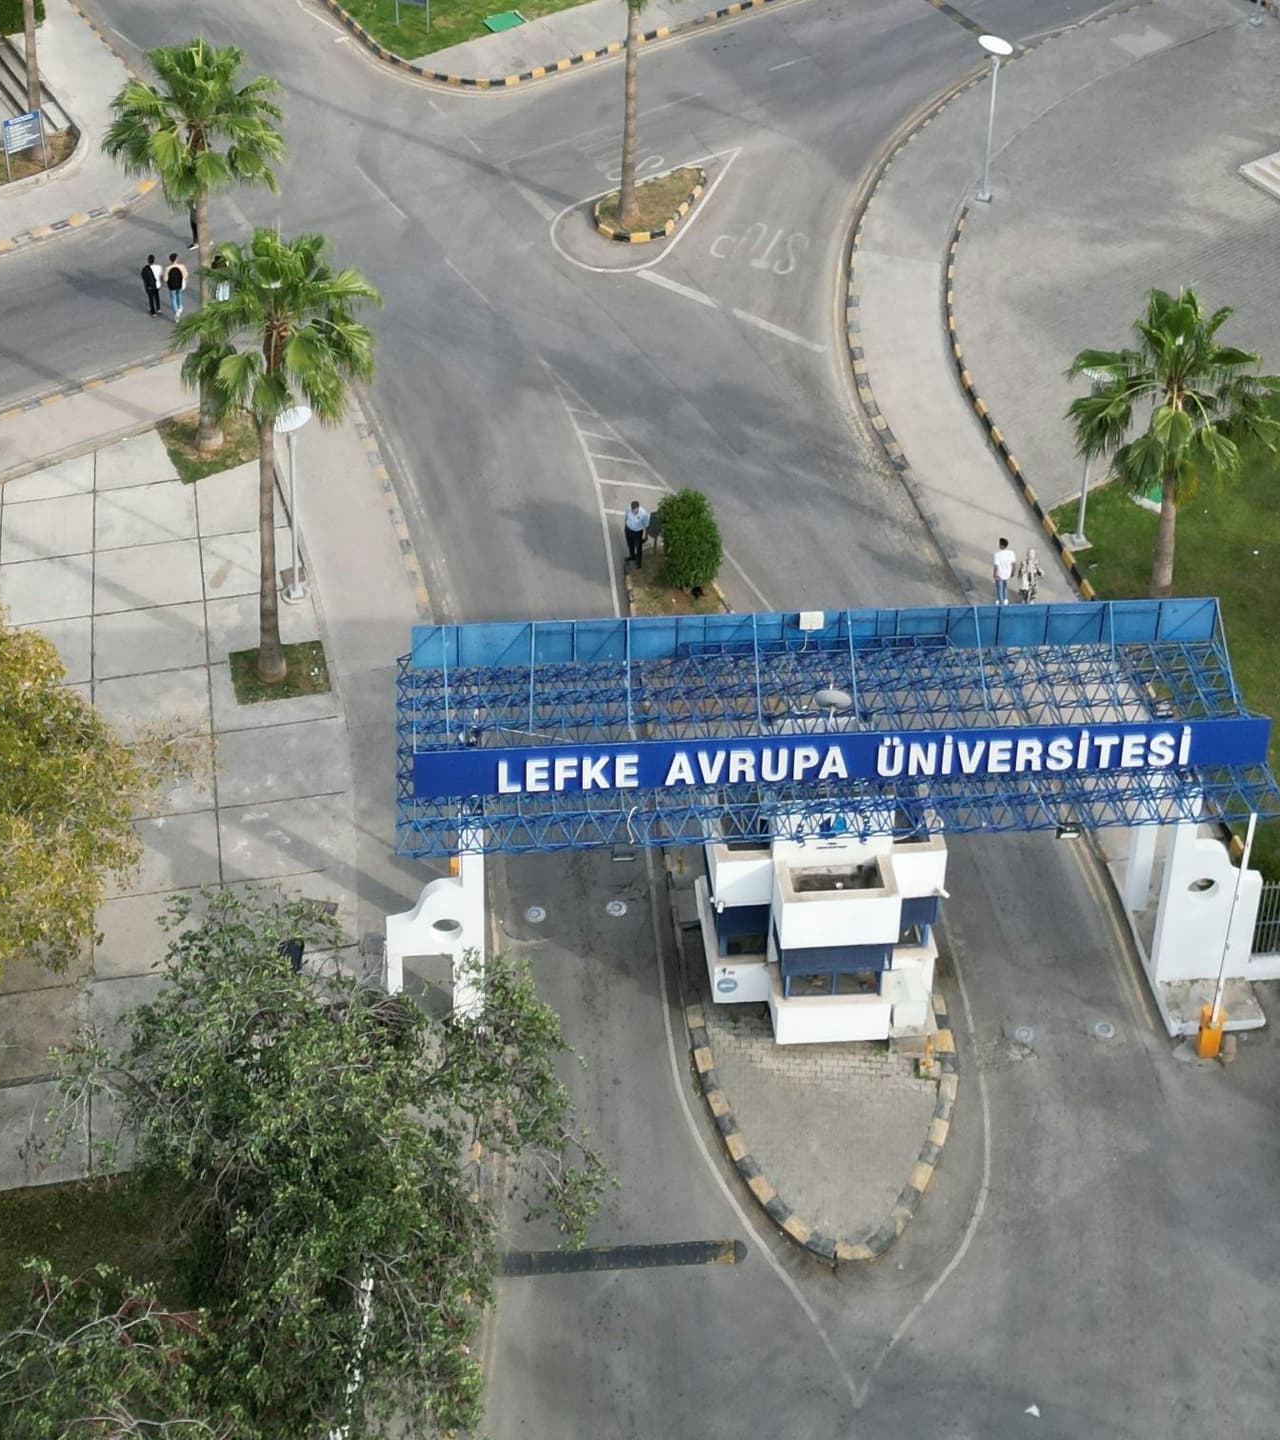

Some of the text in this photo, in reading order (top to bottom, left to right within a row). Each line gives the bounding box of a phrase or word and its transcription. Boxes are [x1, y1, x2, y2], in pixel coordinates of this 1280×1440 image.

[497, 724, 1193, 794] LEFKE AVRUPA ÜNİVERSİTESİ
